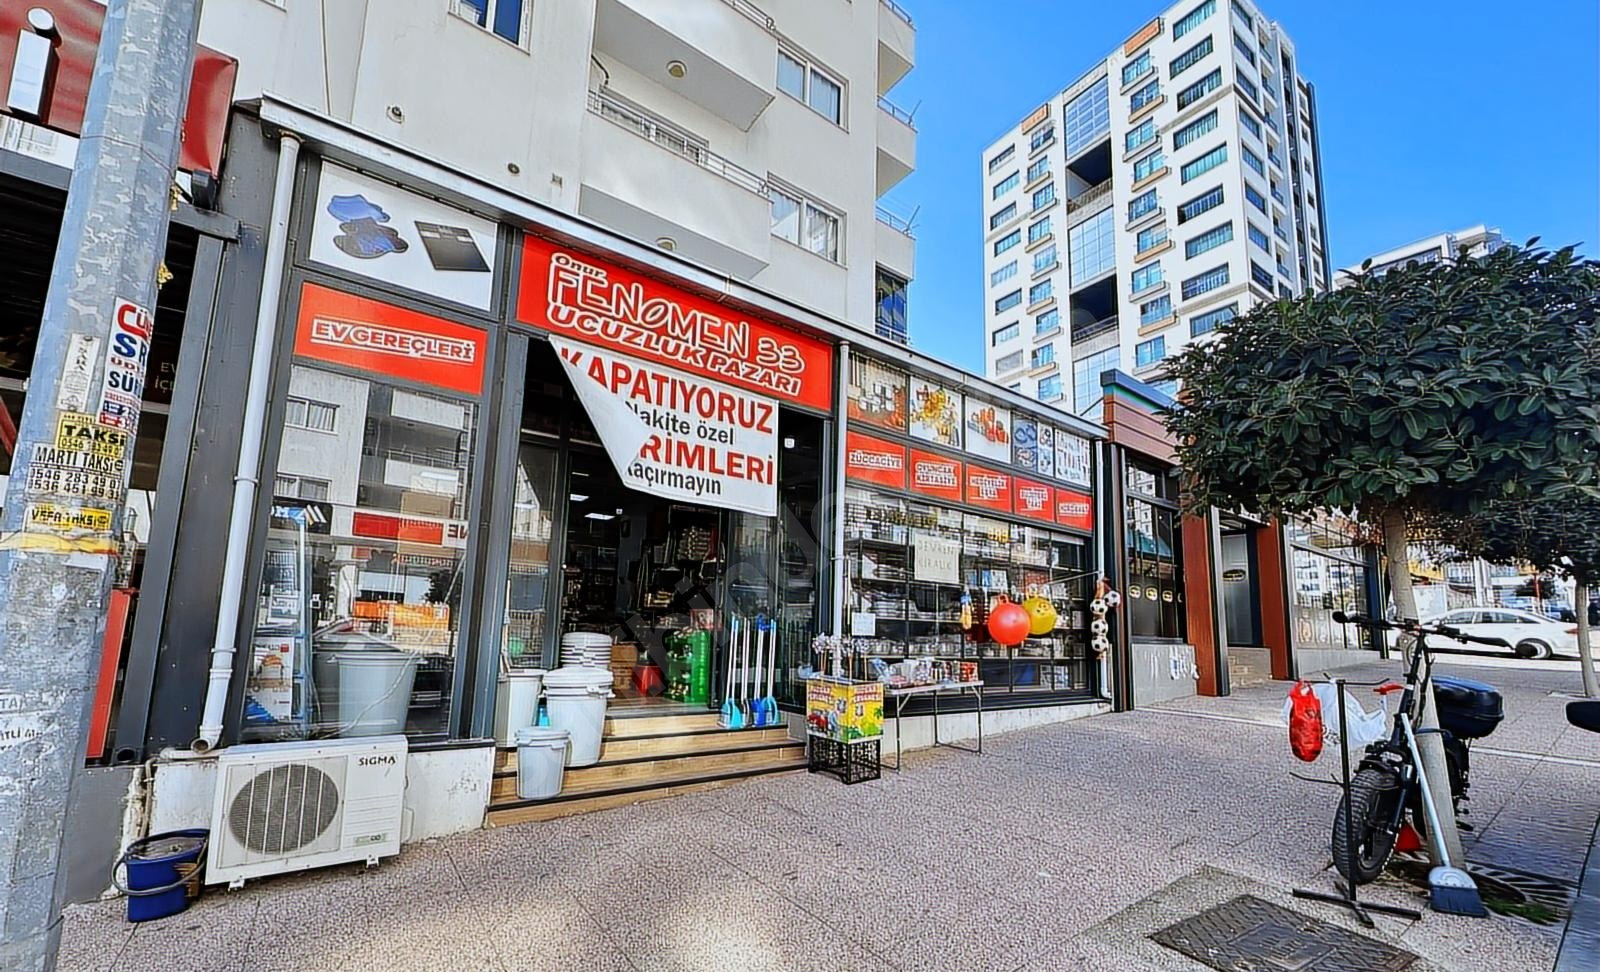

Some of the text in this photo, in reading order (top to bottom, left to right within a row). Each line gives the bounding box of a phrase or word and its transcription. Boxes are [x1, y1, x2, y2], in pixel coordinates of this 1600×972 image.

[551, 253, 608, 280] Onur
[549, 262, 806, 374] FENOMEN 33
[113, 332, 148, 367] SR
[547, 302, 802, 397] UCUZLUK PAZARI
[696, 420, 735, 446] özel
[639, 432, 774, 486] RİMLERİ
[65, 471, 89, 485] 283
[358, 755, 396, 767] SIGMA
